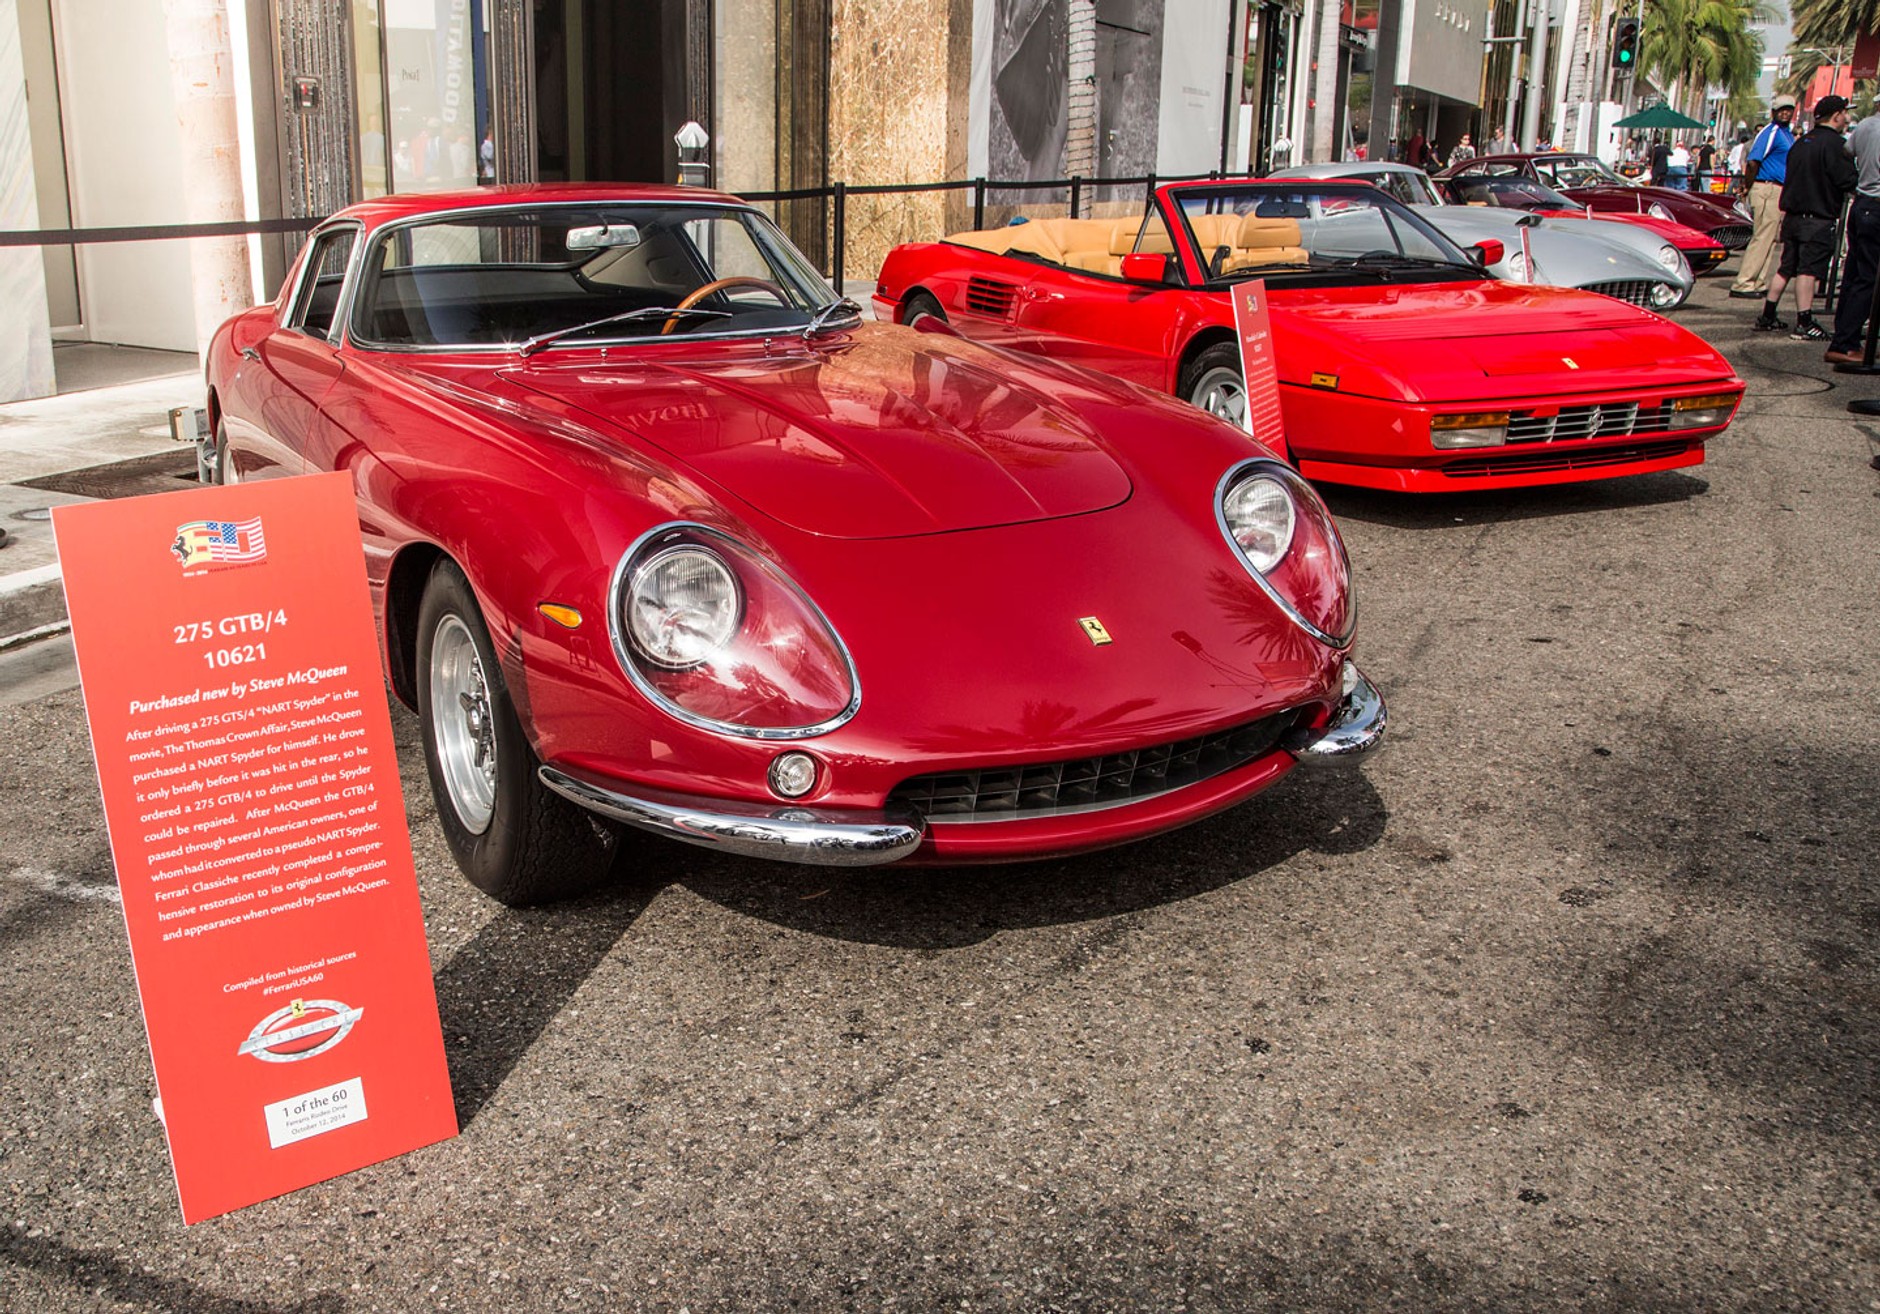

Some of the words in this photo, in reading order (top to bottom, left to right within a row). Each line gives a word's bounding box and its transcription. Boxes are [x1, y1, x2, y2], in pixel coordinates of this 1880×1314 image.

[172, 620, 213, 644] 275
[218, 608, 288, 635] GTB/4
[203, 641, 266, 669] 10621
[125, 728, 153, 742] After
[153, 722, 191, 736] driving
[191, 721, 199, 729] a
[199, 714, 220, 727] 275
[220, 707, 255, 723] GTS/4
[331, 691, 342, 701] in
[342, 688, 359, 699] the
[129, 687, 200, 715] Purchased
[201, 687, 229, 701] new
[230, 681, 247, 699] by
[248, 676, 284, 692] Steve
[286, 664, 347, 685] McQueen
[128, 747, 164, 762] movie,
[162, 743, 184, 755] The
[182, 736, 226, 751] Thomas
[225, 729, 260, 743] Crown
[259, 721, 291, 736] Affair,
[289, 718, 316, 730] Steve
[315, 708, 362, 724] McQueen
[132, 761, 187, 785] purchased
[188, 762, 196, 771] a
[196, 753, 229, 769] NART
[229, 747, 265, 764] Spyder
[265, 743, 282, 754] for
[282, 733, 321, 751] himself.
[322, 732, 337, 743] He
[338, 727, 365, 740] drove
[135, 791, 145, 802] it
[146, 786, 170, 800] only
[170, 779, 204, 795] briefly
[205, 773, 239, 788] before
[240, 770, 249, 780] it
[250, 767, 271, 778] was
[271, 762, 287, 773] hit
[288, 760, 299, 770] in
[300, 756, 317, 767] the
[318, 752, 341, 764] rear,
[342, 749, 355, 759] so
[355, 745, 368, 755] he
[139, 803, 181, 823] ordered
[184, 804, 192, 813] a
[193, 797, 215, 811] 275
[216, 789, 252, 805] GTB/4
[254, 788, 267, 797] to
[268, 781, 293, 794] drive
[295, 774, 318, 788] until
[320, 772, 337, 783] the
[338, 764, 371, 780] Spyder
[143, 826, 173, 842] could
[175, 824, 190, 835] be
[192, 812, 238, 832] repaired.
[245, 807, 271, 820] After
[273, 796, 321, 813] McQueen
[323, 791, 339, 802] the
[341, 782, 374, 798] GTB/4
[147, 844, 184, 865] passed
[184, 835, 226, 854] through
[226, 826, 261, 844] several
[262, 819, 309, 836] American
[309, 810, 347, 825] owners,
[347, 805, 366, 816] one
[366, 799, 378, 812] of
[150, 868, 184, 882] whom
[183, 860, 204, 874] had
[203, 859, 213, 870] it
[212, 847, 262, 868] converted
[261, 847, 274, 856] to
[274, 845, 281, 853] a
[280, 835, 317, 854] pseudo
[315, 827, 345, 843] NART
[345, 821, 380, 837] Spyder.
[154, 884, 189, 902] Ferrari
[191, 874, 239, 893] Classiche
[241, 863, 280, 881] recently
[282, 849, 333, 871] completed
[335, 850, 342, 858] a
[344, 841, 383, 856] compre-
[157, 905, 196, 922] hensive
[198, 891, 255, 911] restoration
[256, 888, 269, 898] to
[270, 884, 284, 894] its
[285, 871, 322, 890] original
[324, 858, 387, 881] configuration
[162, 926, 182, 941] and
[183, 915, 241, 937] appearance
[241, 908, 269, 921] when
[269, 896, 303, 914] owned
[302, 895, 315, 907] by
[315, 889, 341, 903] Steve
[341, 878, 389, 895] McQueen.
[222, 973, 264, 993] Compiled
[264, 970, 286, 981] from
[286, 957, 325, 975] historical
[325, 951, 357, 965] sources
[262, 971, 324, 996] #FerrariUSA60
[282, 1106, 289, 1117] 1
[293, 1099, 307, 1114] of
[308, 1096, 329, 1110] the
[331, 1088, 347, 1102] 60
[285, 1116, 310, 1127] Ferraris
[309, 1109, 331, 1119] Rodeo
[331, 1103, 348, 1113] Drive
[290, 1122, 317, 1135] October
[317, 1118, 329, 1126] 12,
[329, 1112, 346, 1123] 2014
